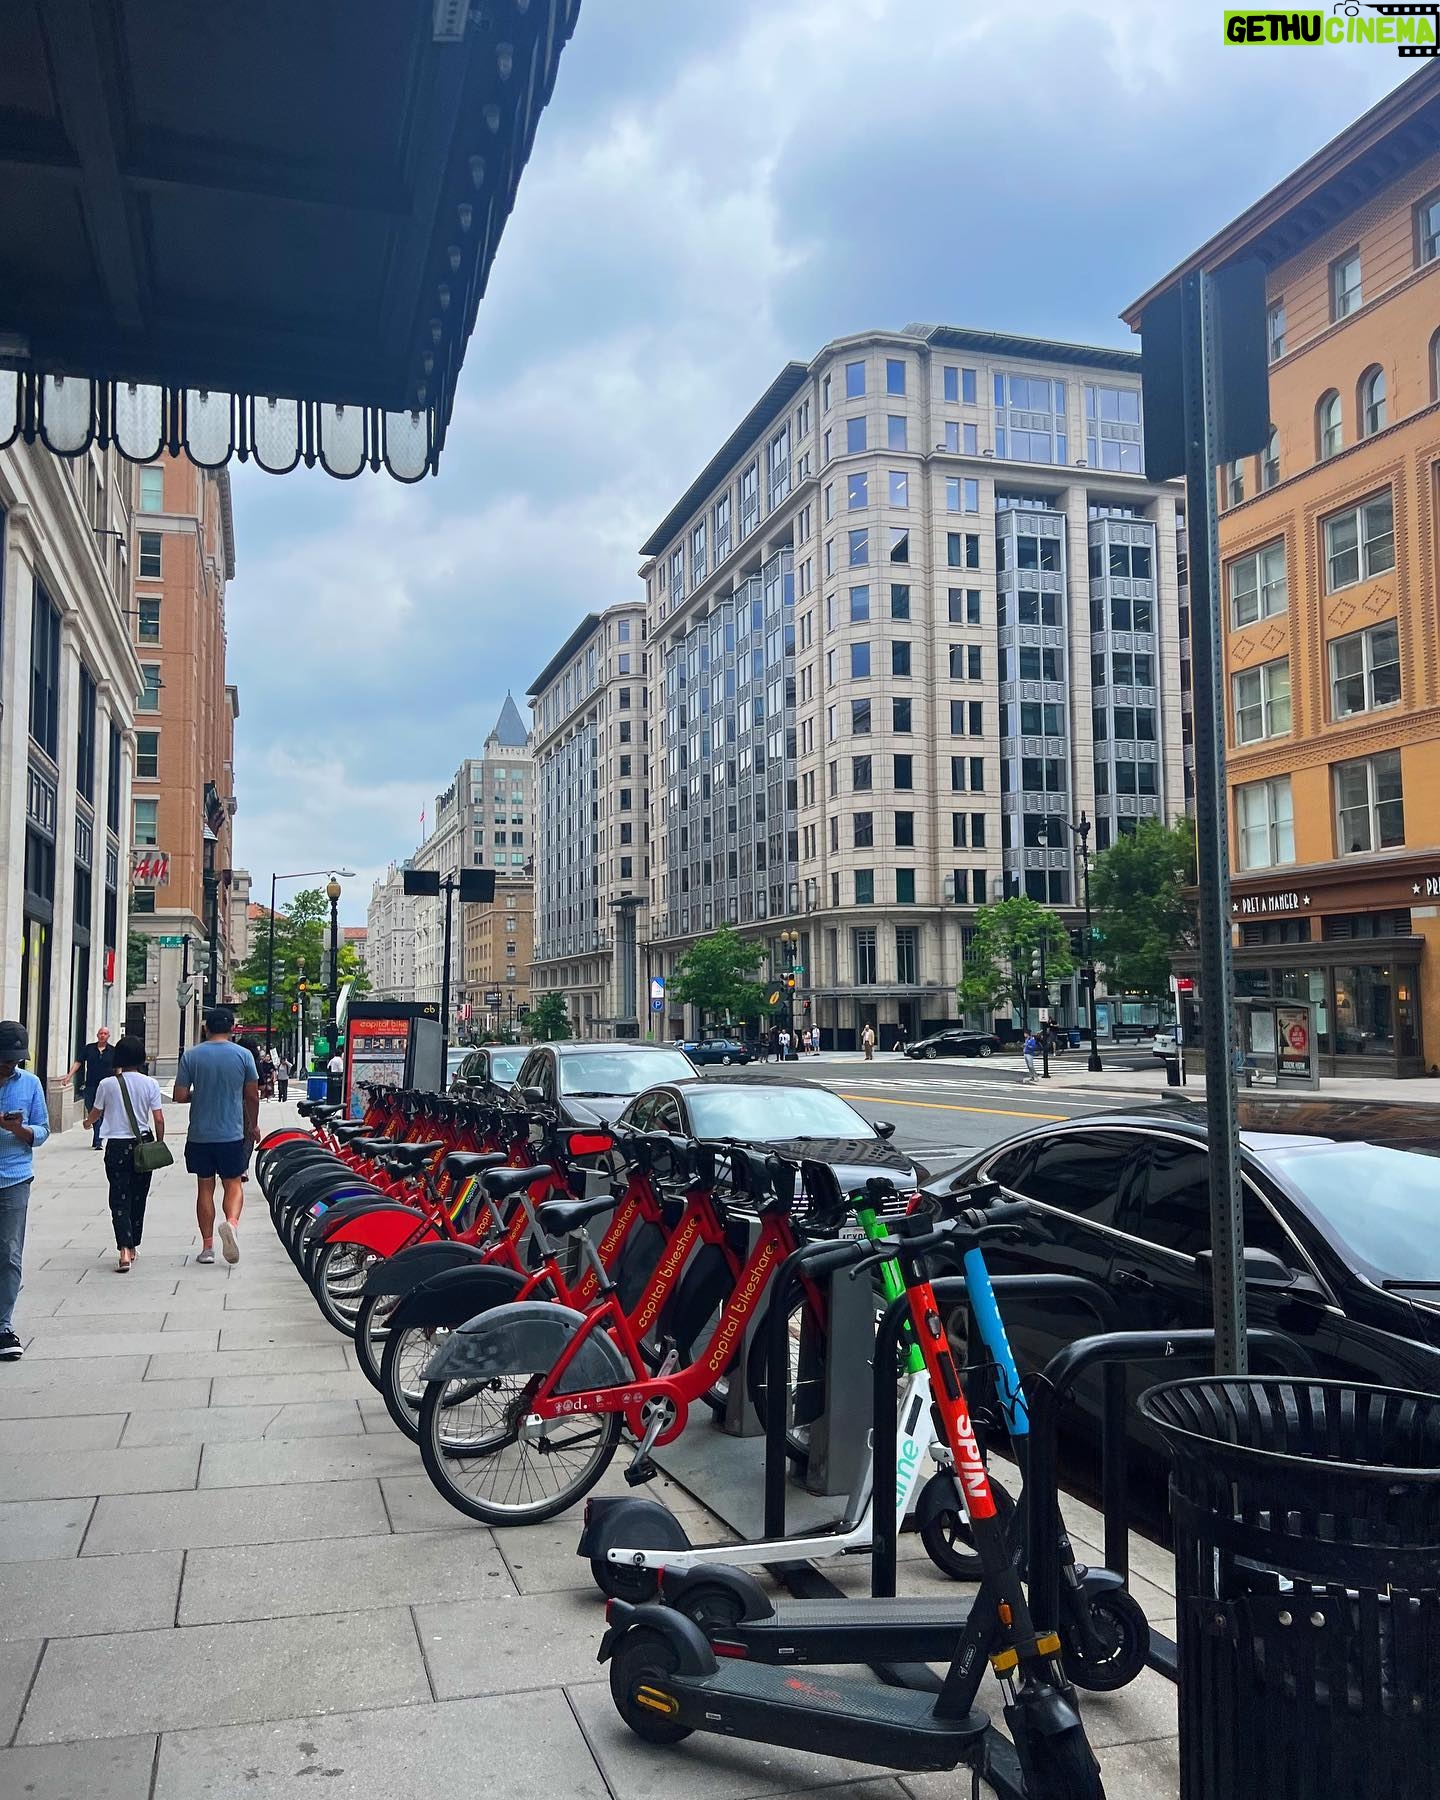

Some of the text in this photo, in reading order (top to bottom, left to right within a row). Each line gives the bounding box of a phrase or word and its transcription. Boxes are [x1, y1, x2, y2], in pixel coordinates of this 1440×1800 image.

[1242, 893, 1299, 913] PRET A MANGER
[360, 1019, 389, 1029] capital
[423, 1005, 436, 1014] cb
[581, 1199, 638, 1297] capal bikeshare
[638, 1217, 697, 1328] capital bikeshare
[709, 1243, 774, 1372] capital bikeshare
[896, 1439, 919, 1508] ime
[957, 1414, 987, 1498] SPIN
